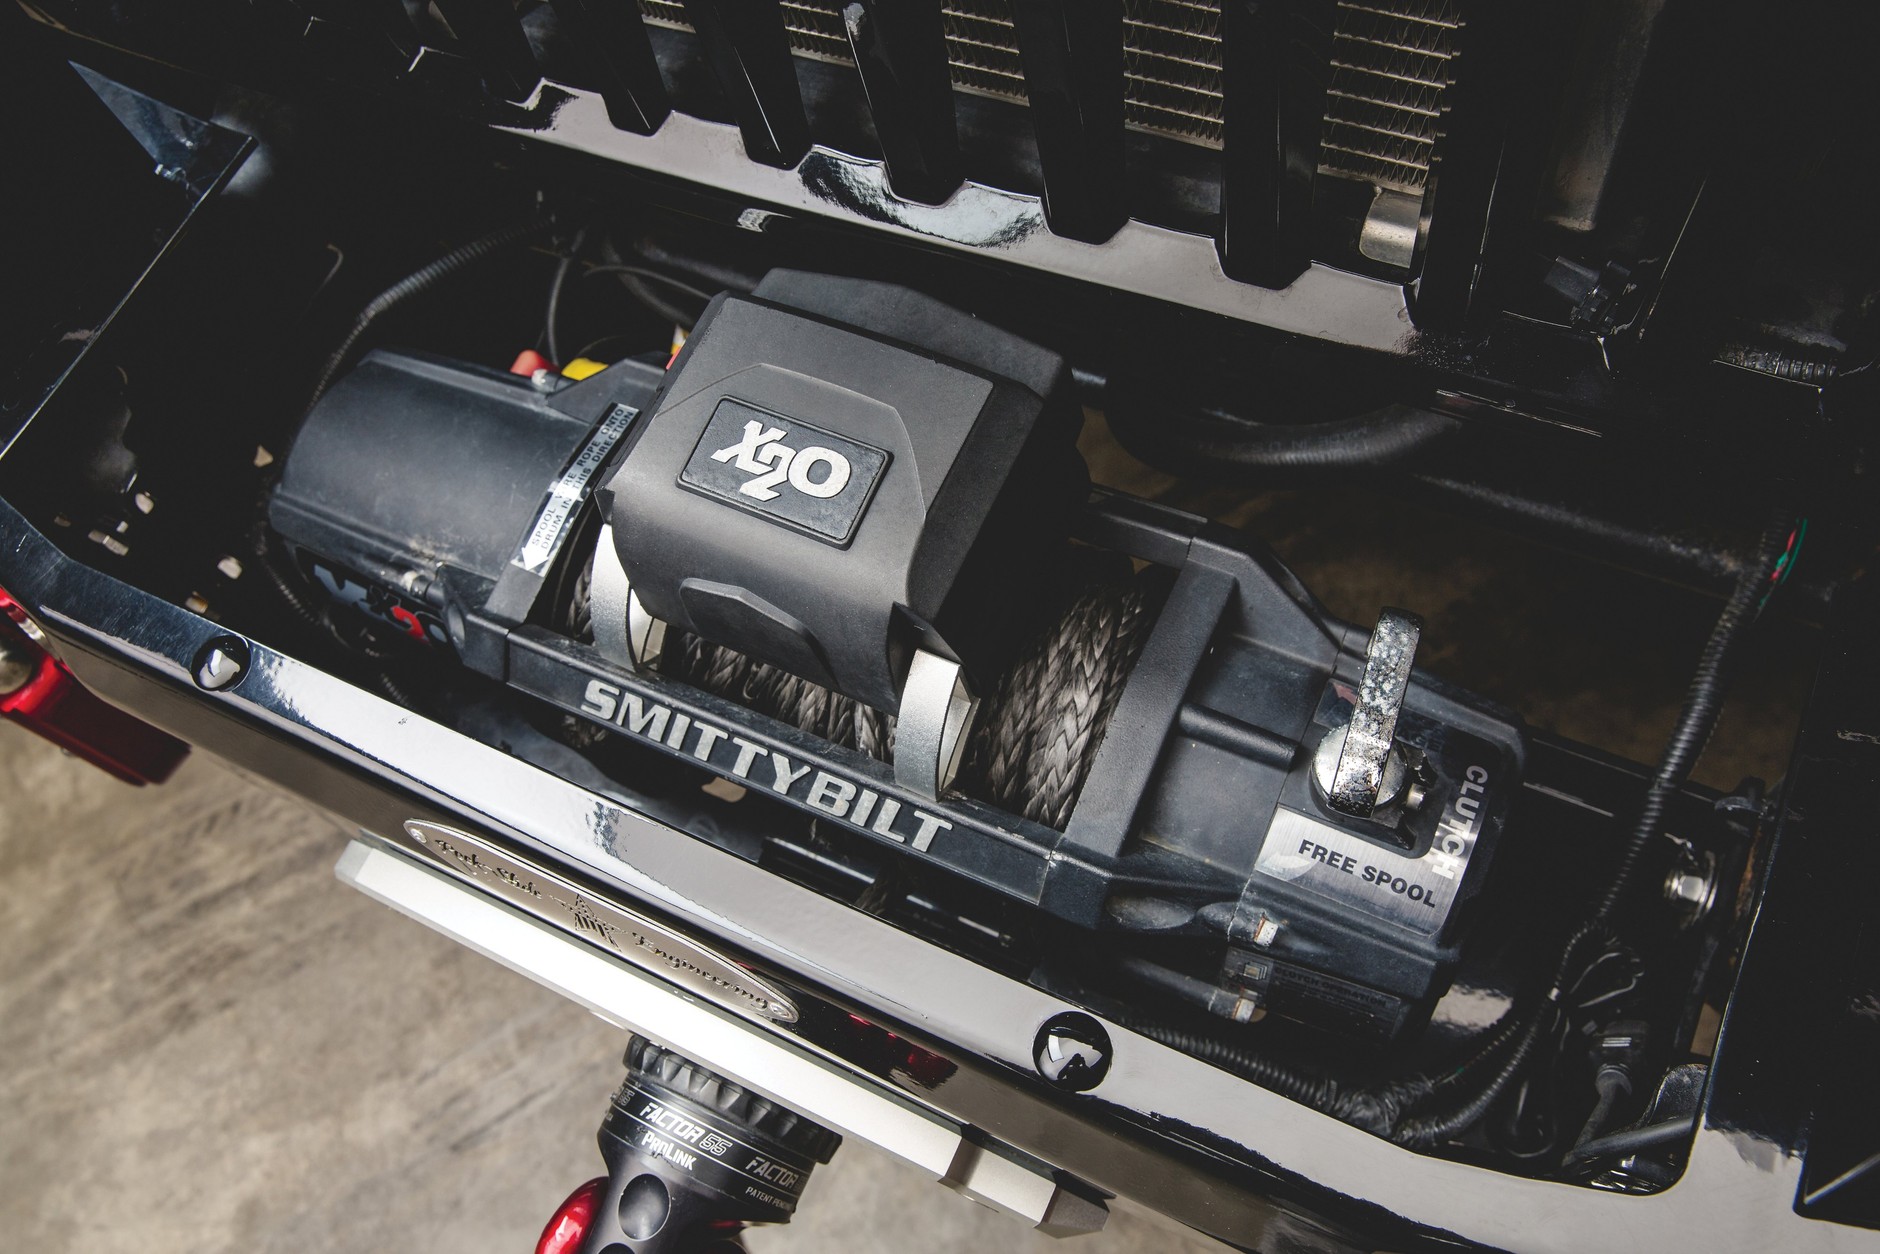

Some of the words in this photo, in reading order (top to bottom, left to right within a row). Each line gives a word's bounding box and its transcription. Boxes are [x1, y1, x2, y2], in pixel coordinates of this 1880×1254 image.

[531, 507, 557, 546] SPOOL
[576, 439, 601, 467] ROPE
[601, 408, 625, 436] ONTO
[541, 514, 563, 551] DRUM
[561, 496, 573, 509] IN
[572, 467, 592, 490] THIS
[591, 410, 634, 463] DIRECTION
[580, 678, 953, 853] SMITTYBILT
[1431, 764, 1488, 880] CLUTCH
[1298, 839, 1358, 875] FREE
[1361, 865, 1436, 908] SPOOL
[639, 1101, 706, 1144] FACTOR
[699, 1133, 733, 1156] 55
[745, 1156, 799, 1190] FACTOR
[745, 1186, 774, 1204] PATENT
